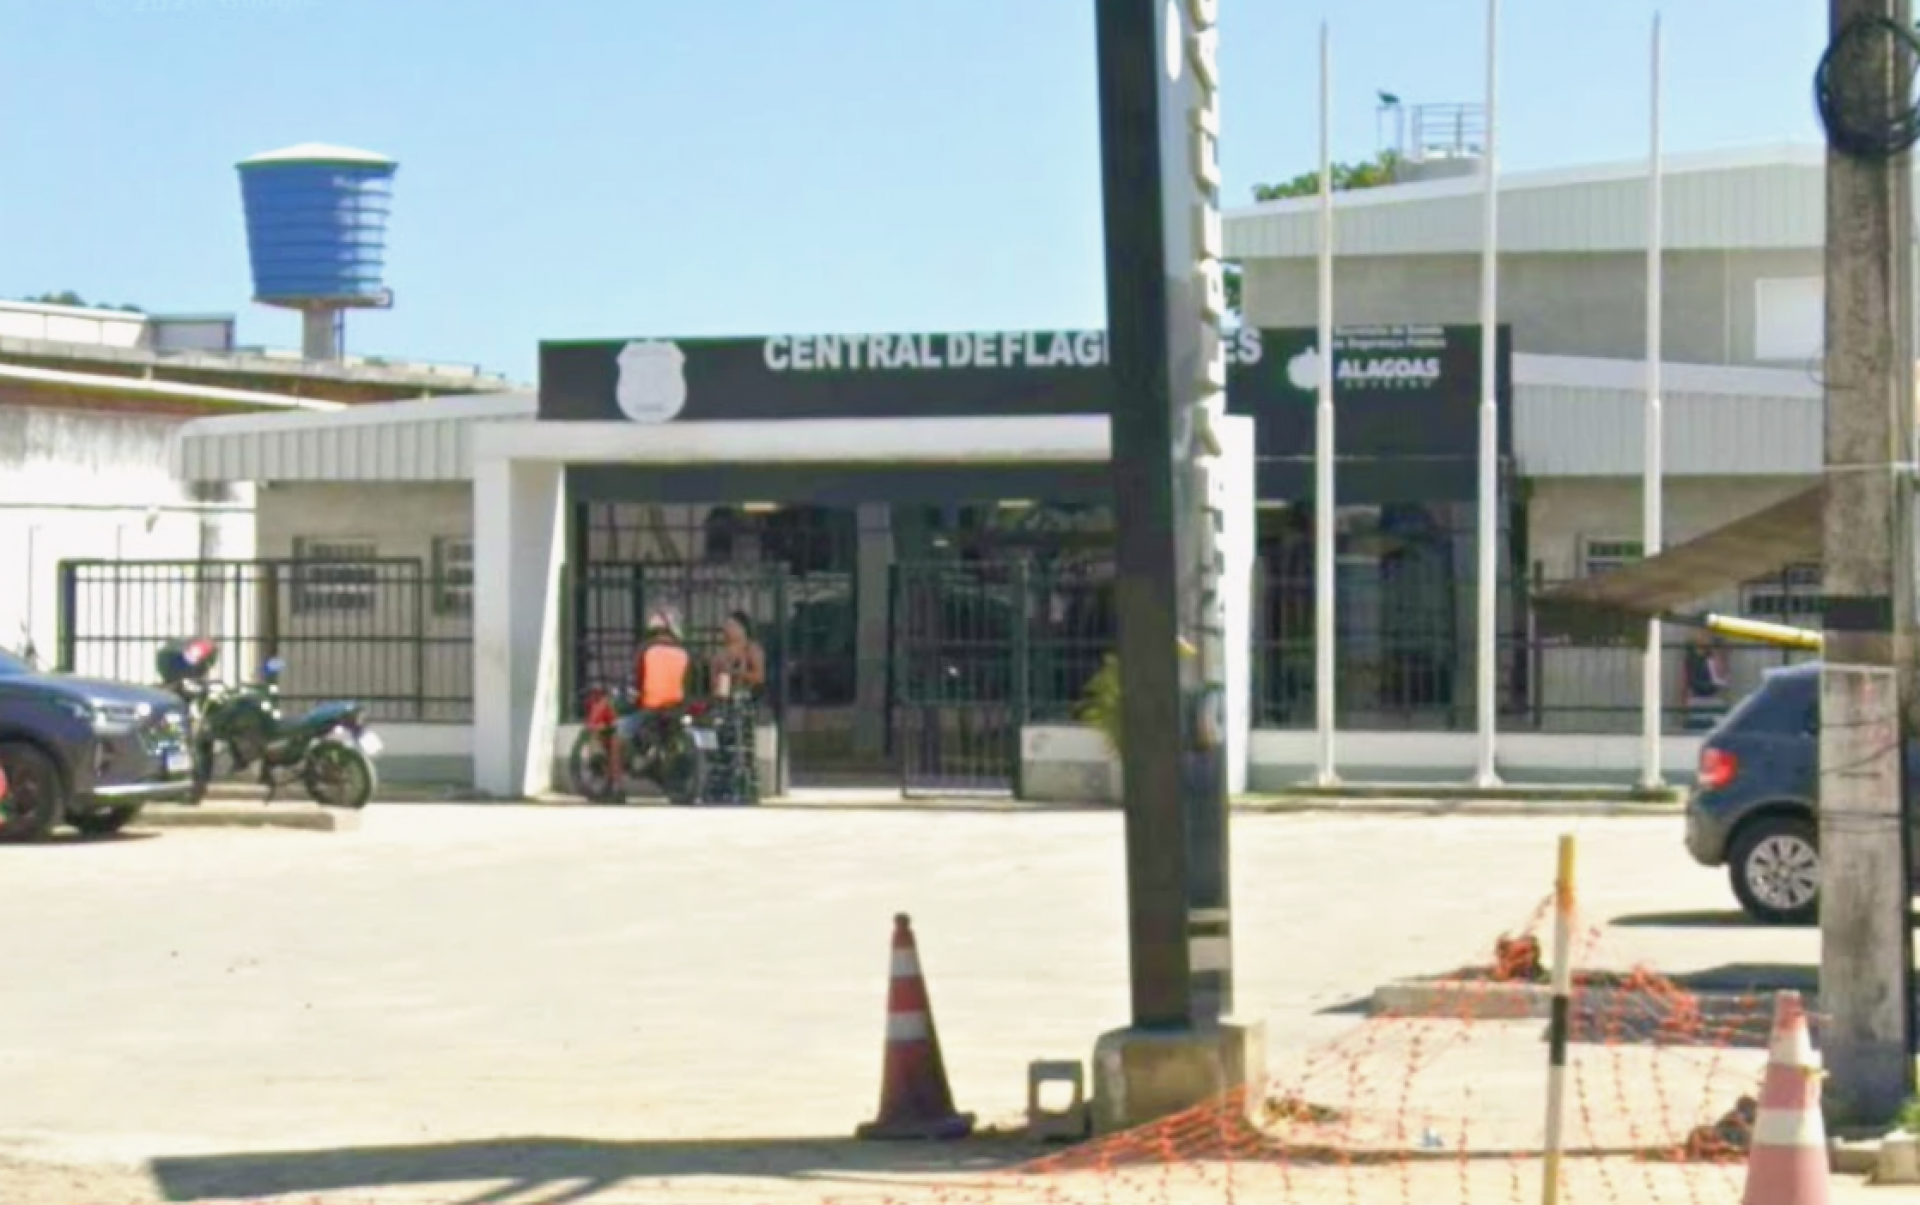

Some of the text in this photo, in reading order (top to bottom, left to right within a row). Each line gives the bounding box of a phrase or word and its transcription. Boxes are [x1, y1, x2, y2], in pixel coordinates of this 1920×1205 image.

[764, 329, 1261, 370] CENTRAL DE FLAGES
[1337, 357, 1440, 378] ALAGOAS
